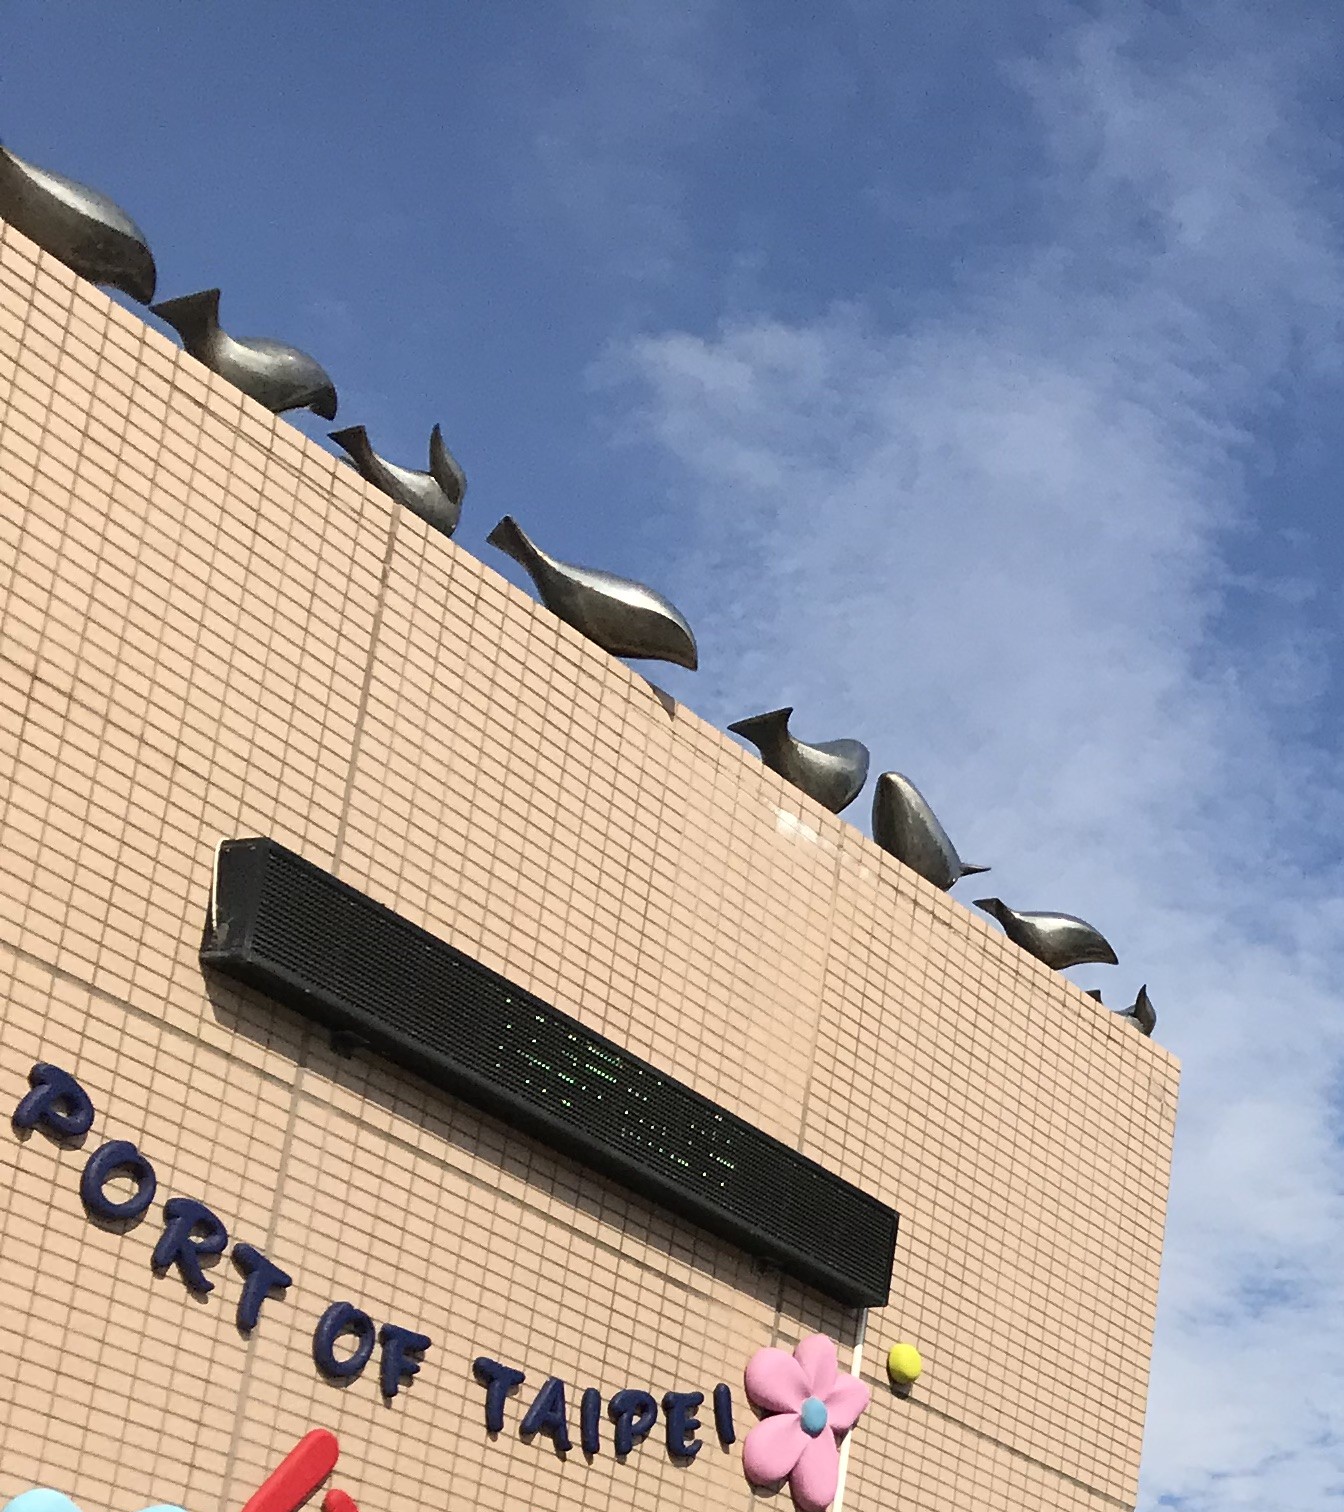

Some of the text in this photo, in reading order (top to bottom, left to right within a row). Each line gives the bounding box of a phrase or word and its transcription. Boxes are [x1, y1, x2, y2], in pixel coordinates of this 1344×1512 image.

[13, 1062, 736, 1459] PORT OF TAIPEI
